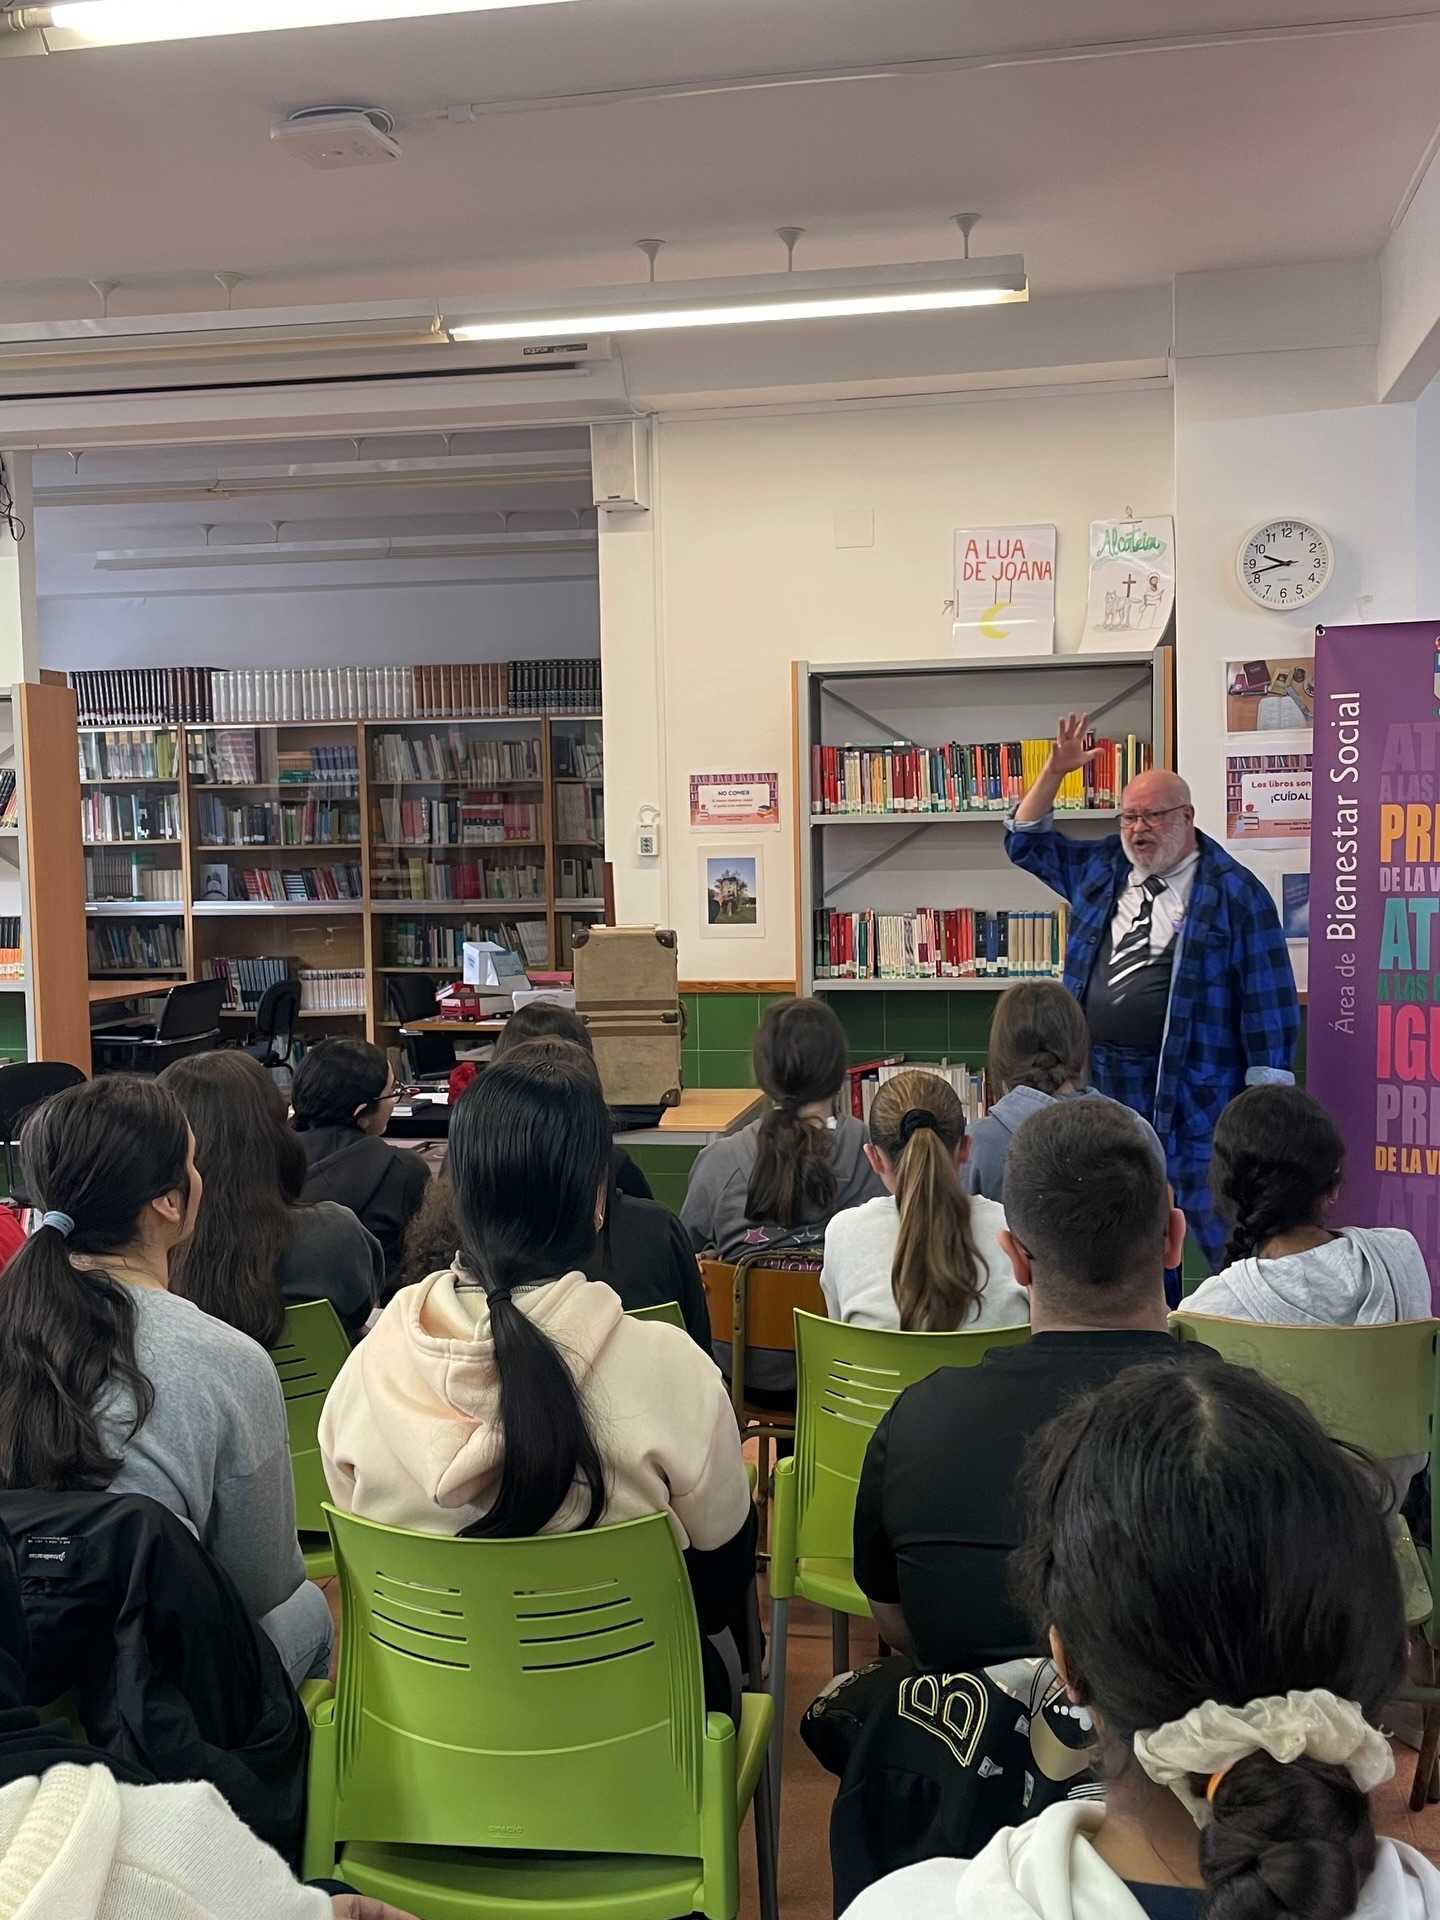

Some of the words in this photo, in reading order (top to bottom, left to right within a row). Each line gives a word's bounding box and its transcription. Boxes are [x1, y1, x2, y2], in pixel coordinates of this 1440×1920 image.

[1266, 533, 1276, 543] 11
[1281, 527, 1293, 538] 12
[965, 539, 979, 559] A
[986, 539, 1025, 559] LUA
[1254, 543, 1266, 554] 10
[1309, 542, 1317, 553] 2
[1248, 558, 1257, 569] 9
[1313, 558, 1321, 568] 3
[963, 561, 987, 581] DE
[992, 560, 1053, 581] JOANA
[1253, 573, 1261, 583] 8
[1308, 573, 1315, 582] 4
[1264, 584, 1272, 595] 7
[1279, 587, 1287, 598] 6
[1295, 584, 1303, 594] 5
[1329, 692, 1360, 783] Social
[1269, 780, 1294, 788] libros
[1326, 794, 1358, 940] Bienestar
[1380, 866, 1401, 892] DE
[1404, 866, 1426, 892] LA
[1379, 897, 1440, 971] AT
[1335, 953, 1356, 978] de
[1329, 985, 1356, 1034] Área
[1375, 1145, 1398, 1172] DE
[1400, 1147, 1423, 1175] LA
[1425, 1149, 1440, 1176] V
